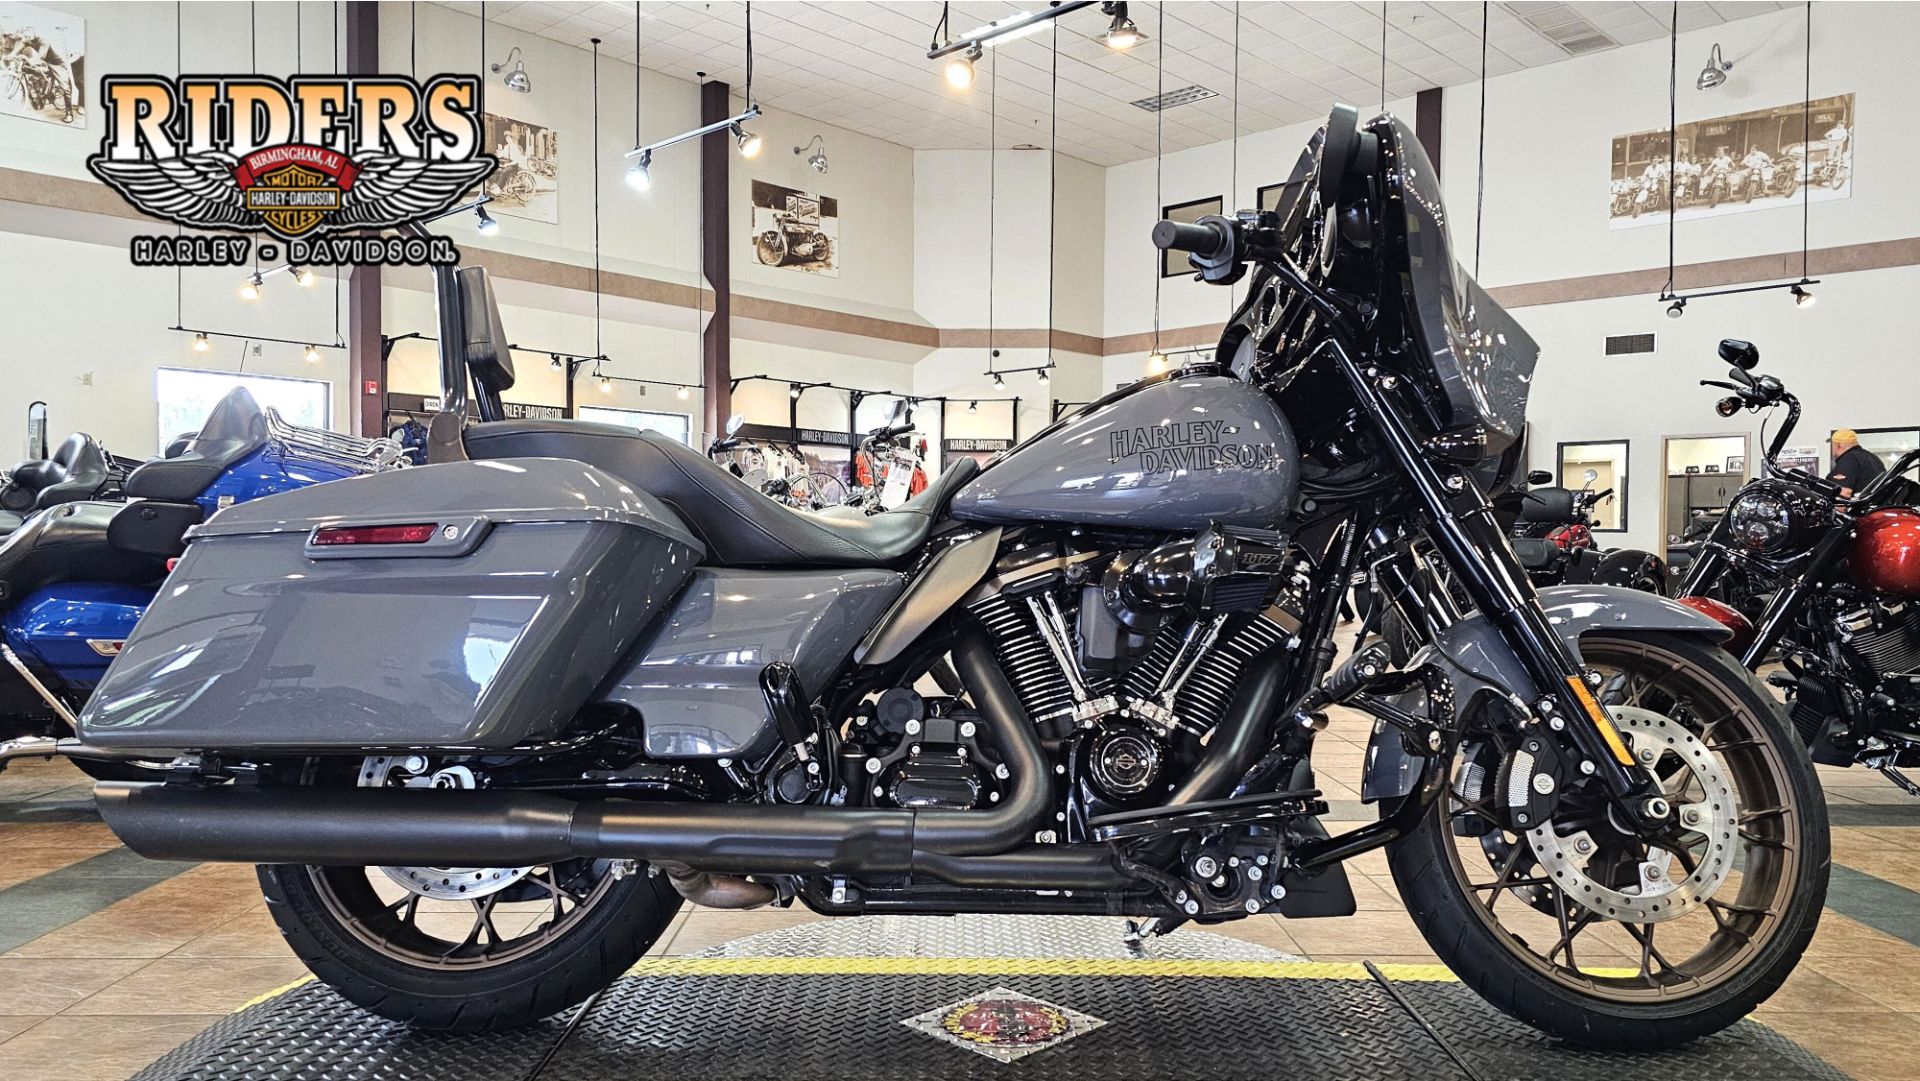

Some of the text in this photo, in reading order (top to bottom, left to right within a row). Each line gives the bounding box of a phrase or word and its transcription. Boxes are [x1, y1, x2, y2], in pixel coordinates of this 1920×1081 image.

[801, 430, 849, 445] HARLEY-DAVIDSON
[950, 439, 1007, 450] HARLEY-DAVIDSON
[1139, 444, 1273, 476] DAVIDSON
